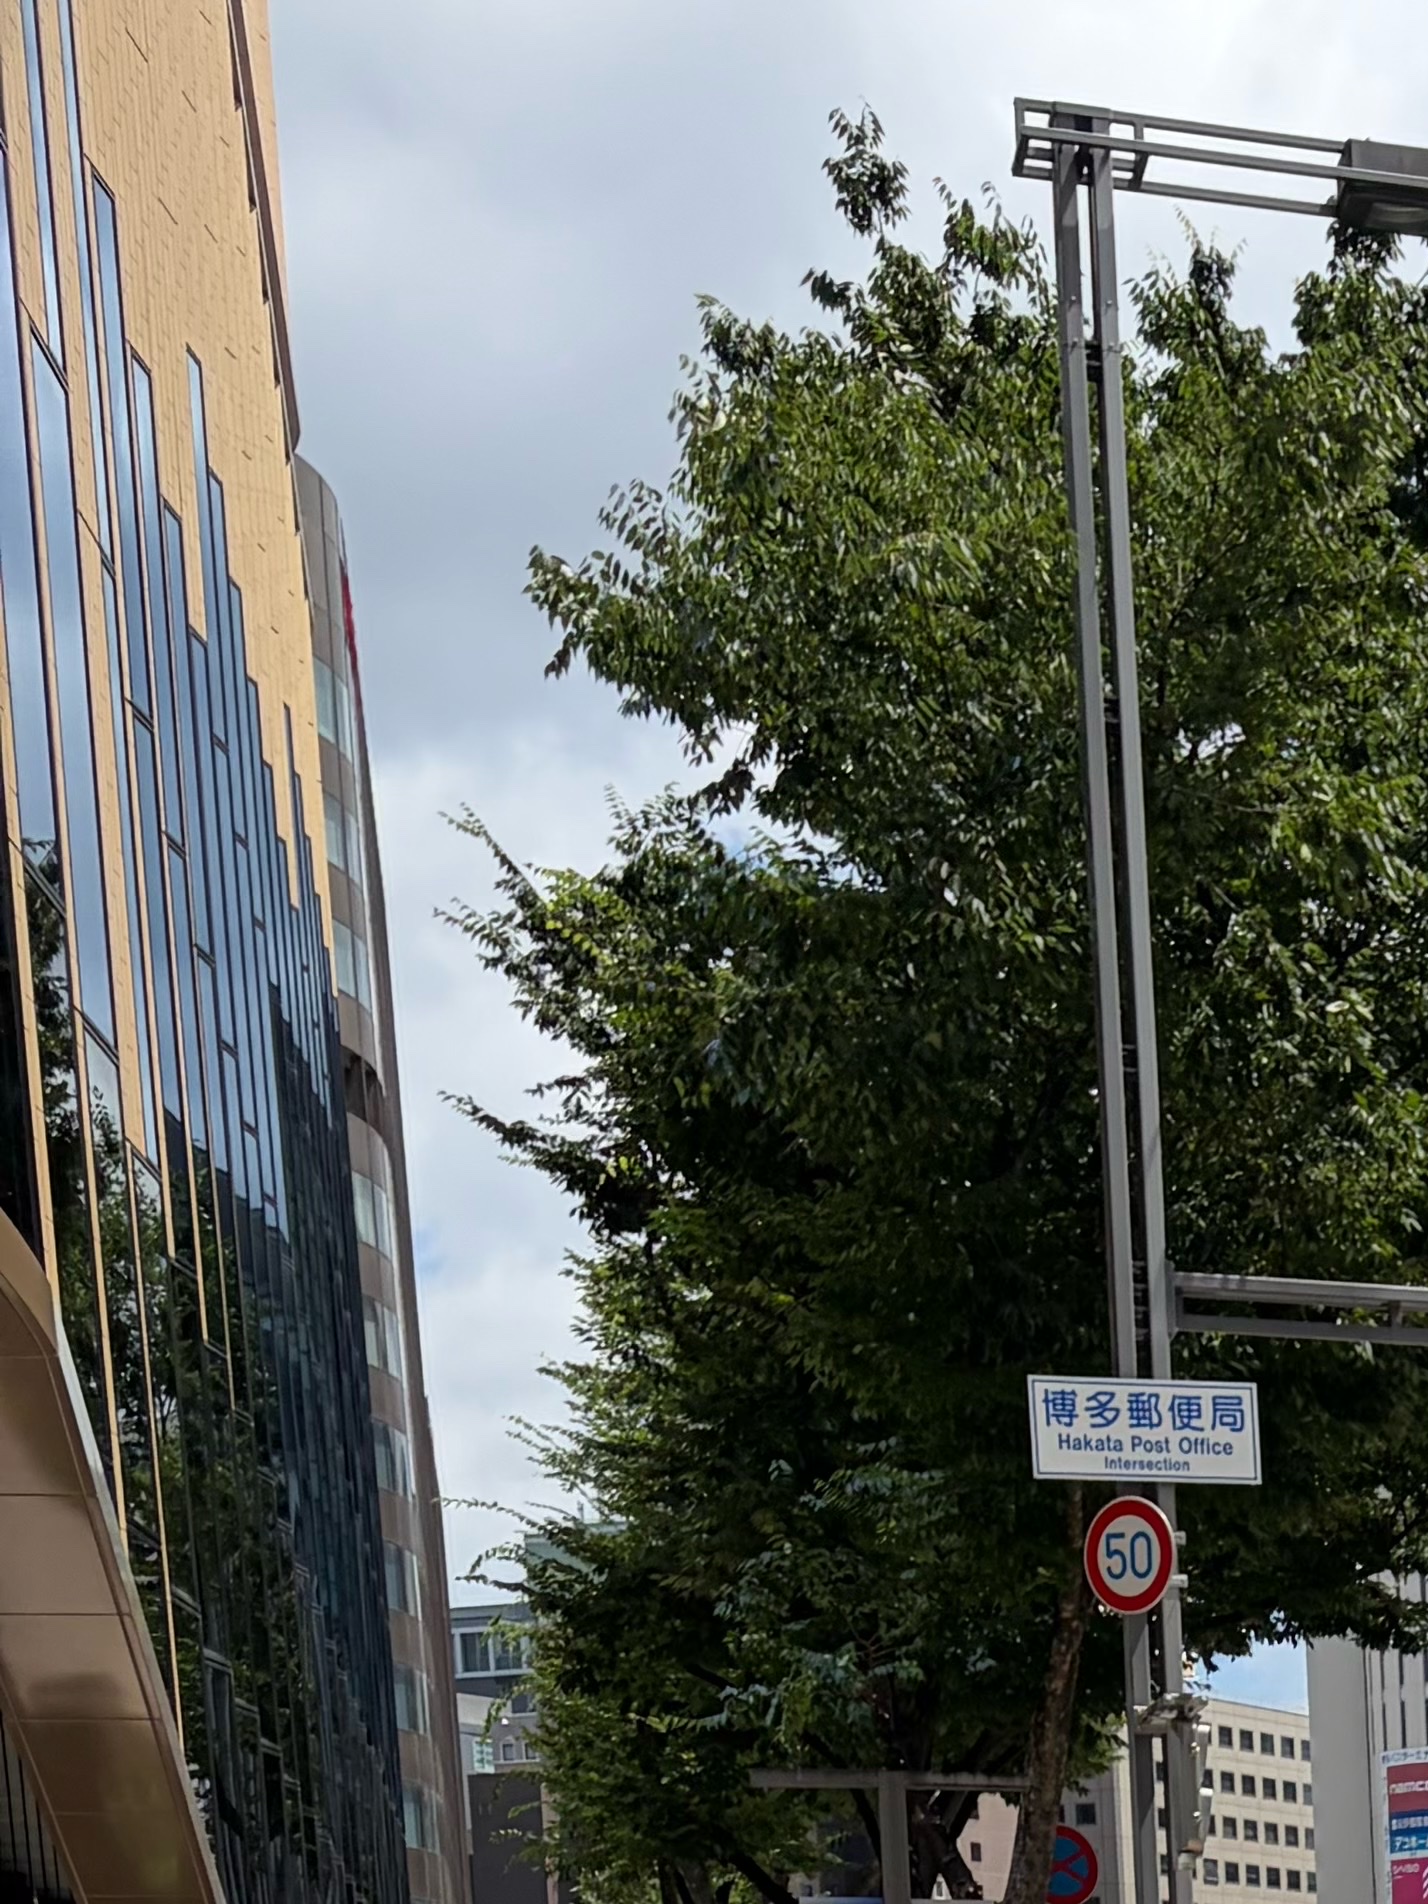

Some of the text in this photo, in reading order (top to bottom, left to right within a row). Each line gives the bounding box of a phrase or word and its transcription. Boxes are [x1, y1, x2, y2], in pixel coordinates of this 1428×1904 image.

[1042, 1388, 1245, 1433] 博多郵便局
[1058, 1433, 1234, 1456] Hakata Post Office
[1104, 1456, 1190, 1472] Intersection
[1105, 1531, 1153, 1580] 50
